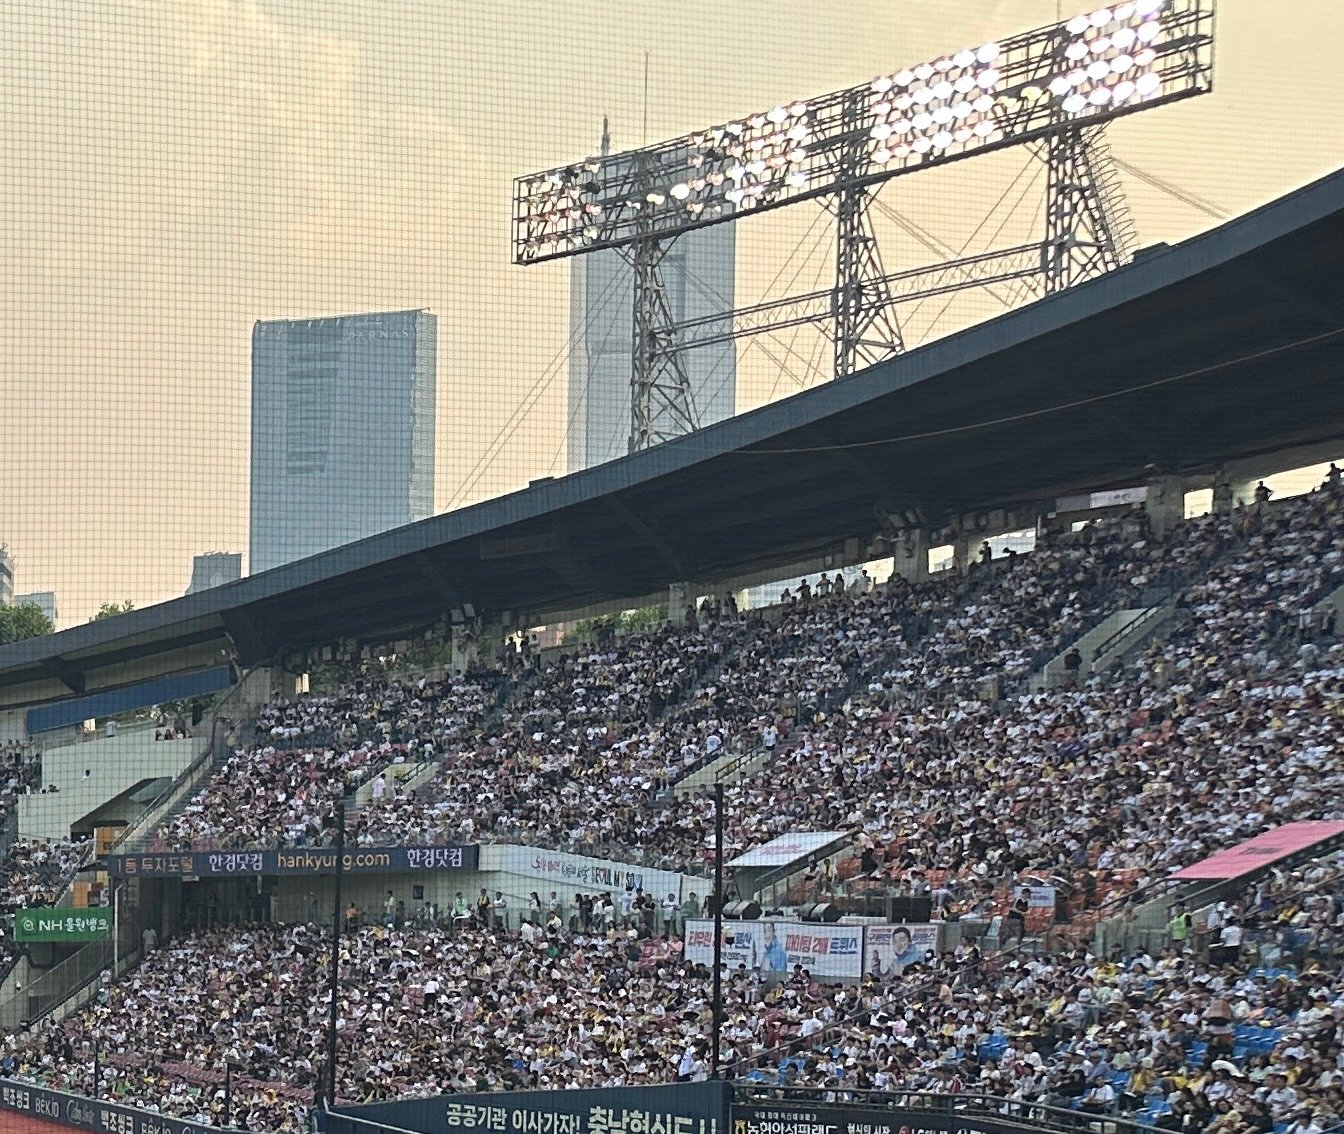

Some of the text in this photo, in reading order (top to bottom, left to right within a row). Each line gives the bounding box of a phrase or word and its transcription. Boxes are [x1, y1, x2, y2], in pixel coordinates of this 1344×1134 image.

[209, 853, 263, 872] 한경닷컴
[407, 848, 462, 868] 한경닷컴
[38, 920, 62, 931] NH
[446, 1102, 507, 1132] 공공기관
